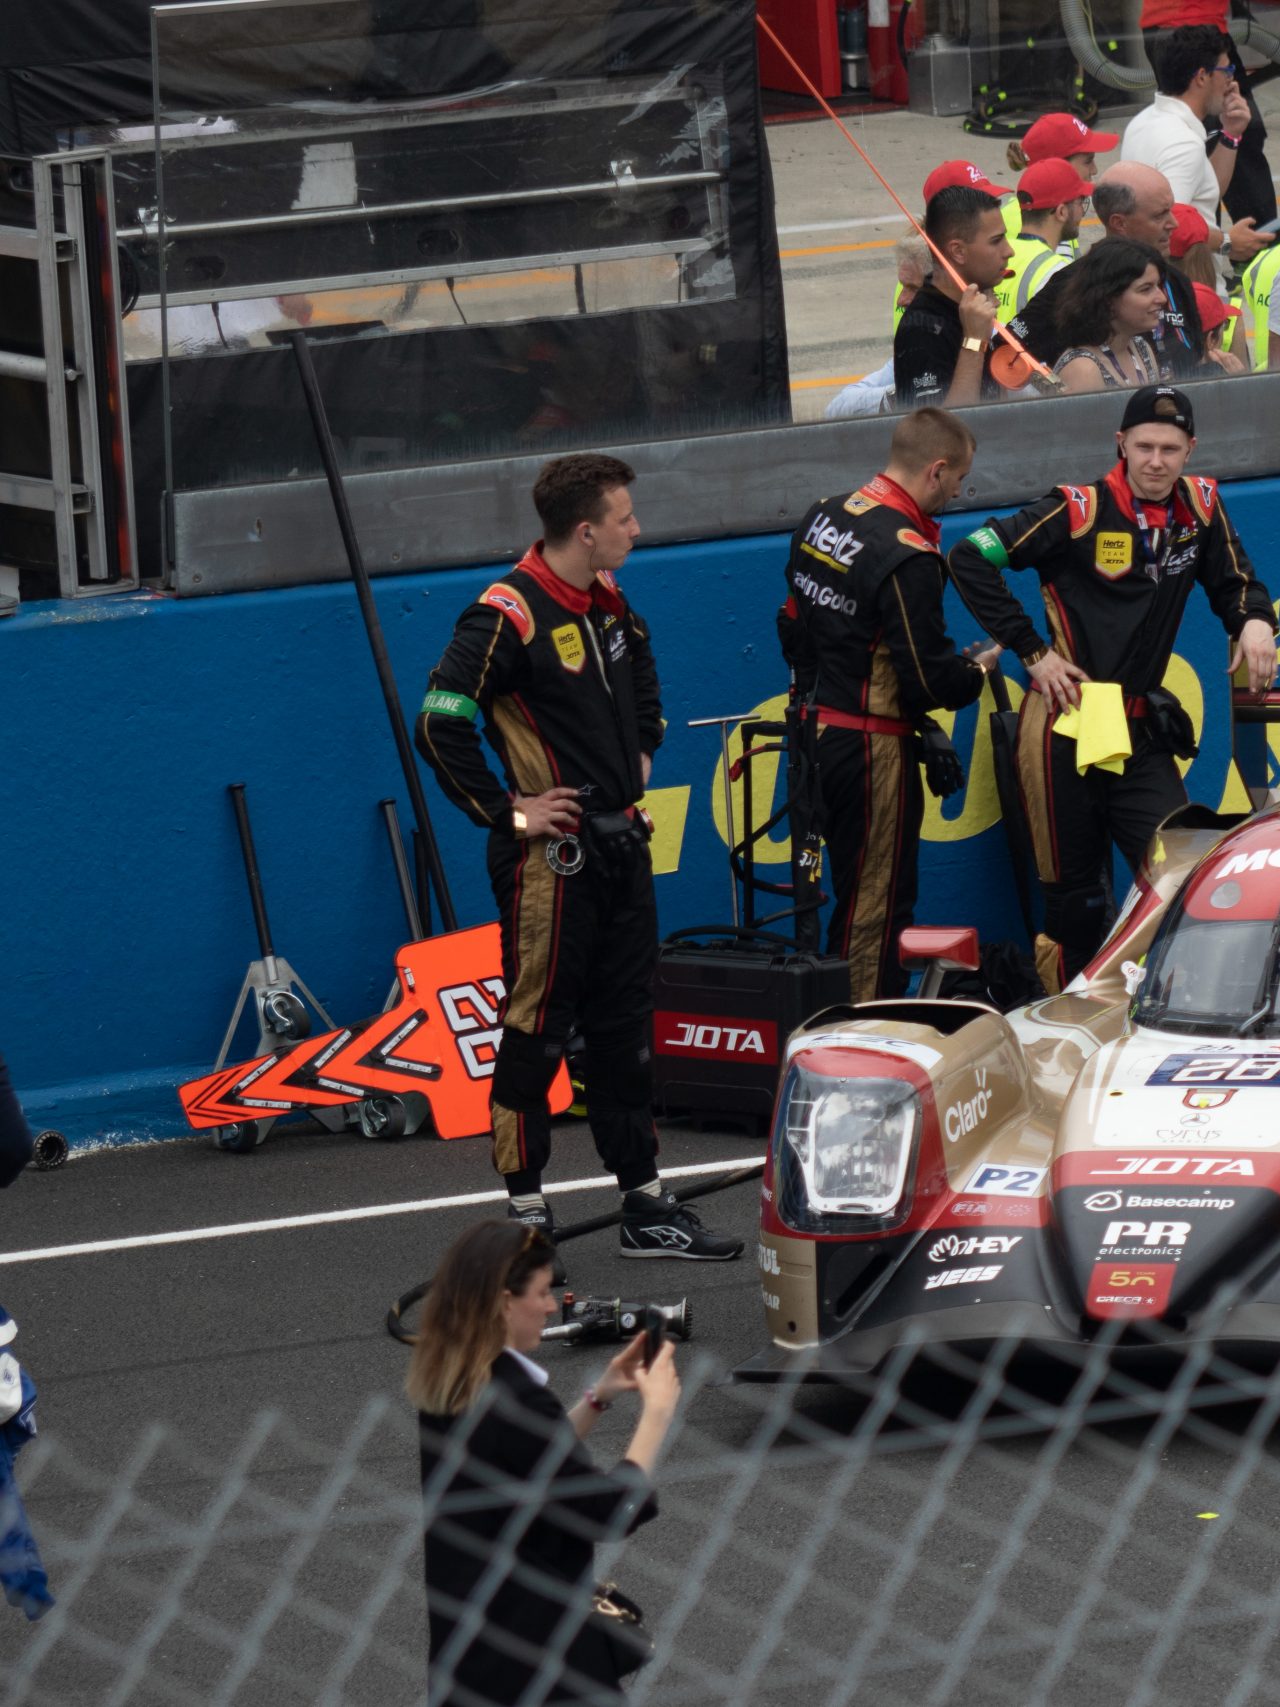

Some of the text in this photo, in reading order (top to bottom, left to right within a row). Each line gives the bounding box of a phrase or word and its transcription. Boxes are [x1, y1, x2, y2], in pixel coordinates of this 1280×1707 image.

[1103, 539, 1126, 549] Hertz
[665, 1023, 765, 1054] JOTA
[945, 1089, 989, 1143] Claro
[1088, 1157, 1255, 1176] JOTA
[973, 1167, 1039, 1192] P2
[952, 1203, 989, 1214] FIA
[1126, 1195, 1235, 1210] Basecamp
[1102, 1221, 1192, 1245] PR
[964, 1236, 1023, 1255] HEY
[1099, 1246, 1182, 1256] electronics
